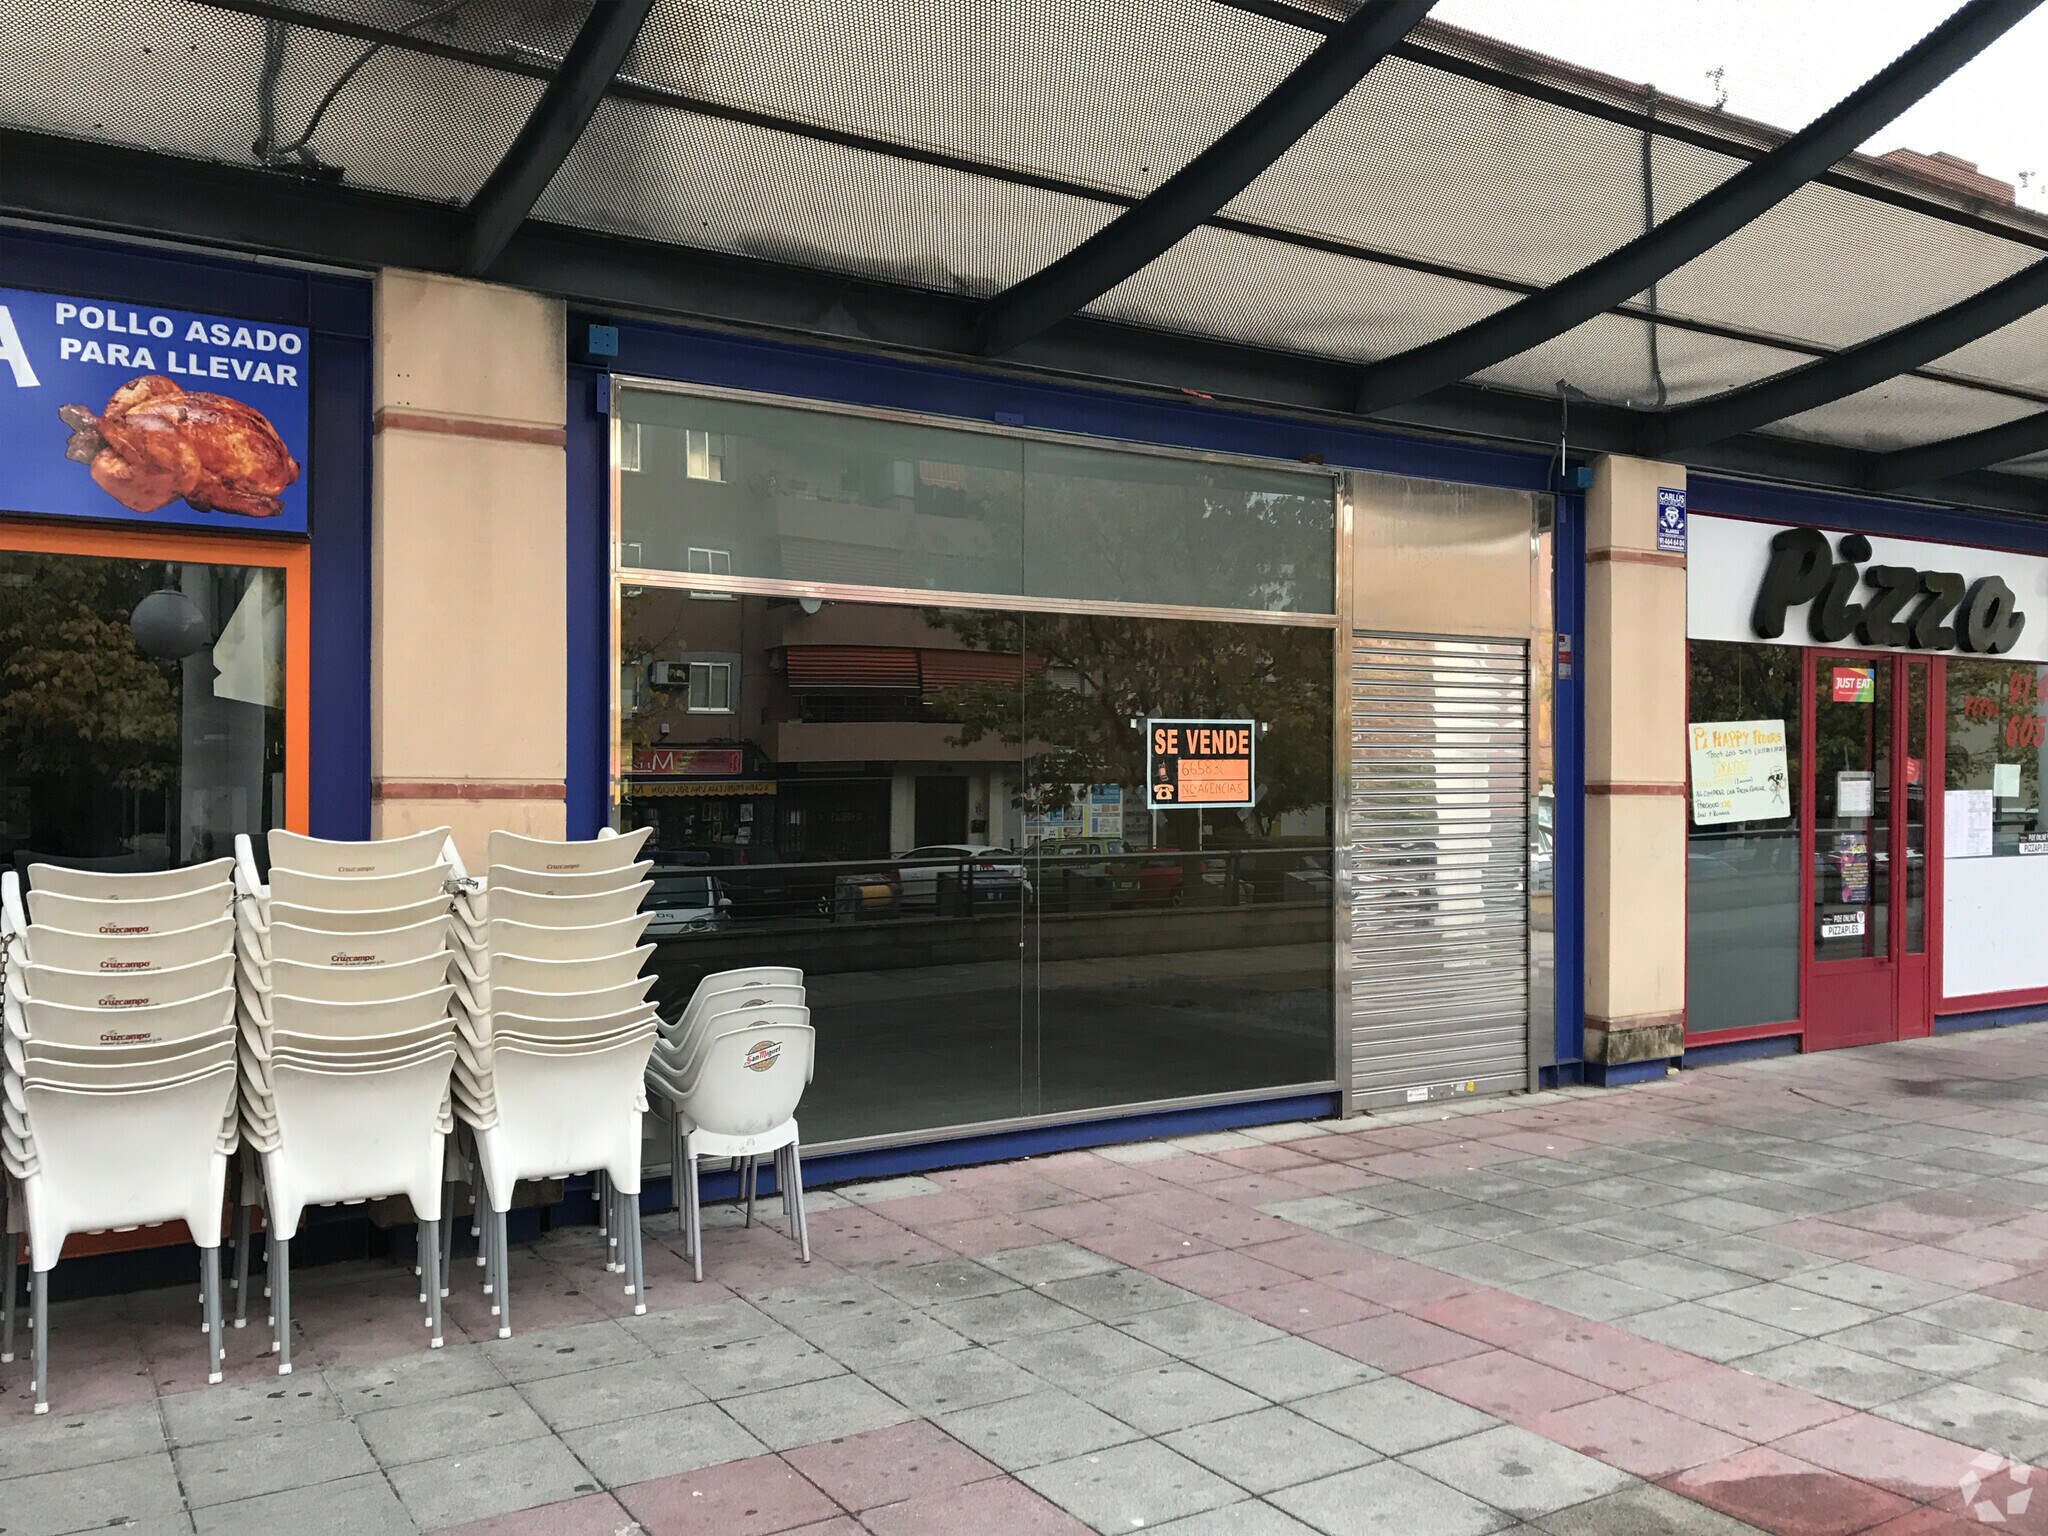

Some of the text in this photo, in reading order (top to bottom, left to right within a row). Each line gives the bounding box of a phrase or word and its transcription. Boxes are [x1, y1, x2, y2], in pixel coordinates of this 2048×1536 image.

[55, 302, 301, 355] POLLO ASADO
[60, 337, 298, 387] PARA LLEVAR
[1753, 527, 2026, 654] Pizza
[1836, 677, 1872, 689] JUST EAT
[2008, 672, 2033, 707] 91
[1154, 728, 1249, 755] SE VENDE
[1712, 730, 1749, 748] HAPPY
[1753, 729, 1782, 745] HOURS
[2005, 715, 2047, 748] 605
[1182, 783, 1243, 795] NO AGENCIAS
[99, 926, 149, 934] Cruzcampo
[98, 998, 149, 1006] Cruzcampo
[100, 1032, 151, 1041] Cruzcampo
